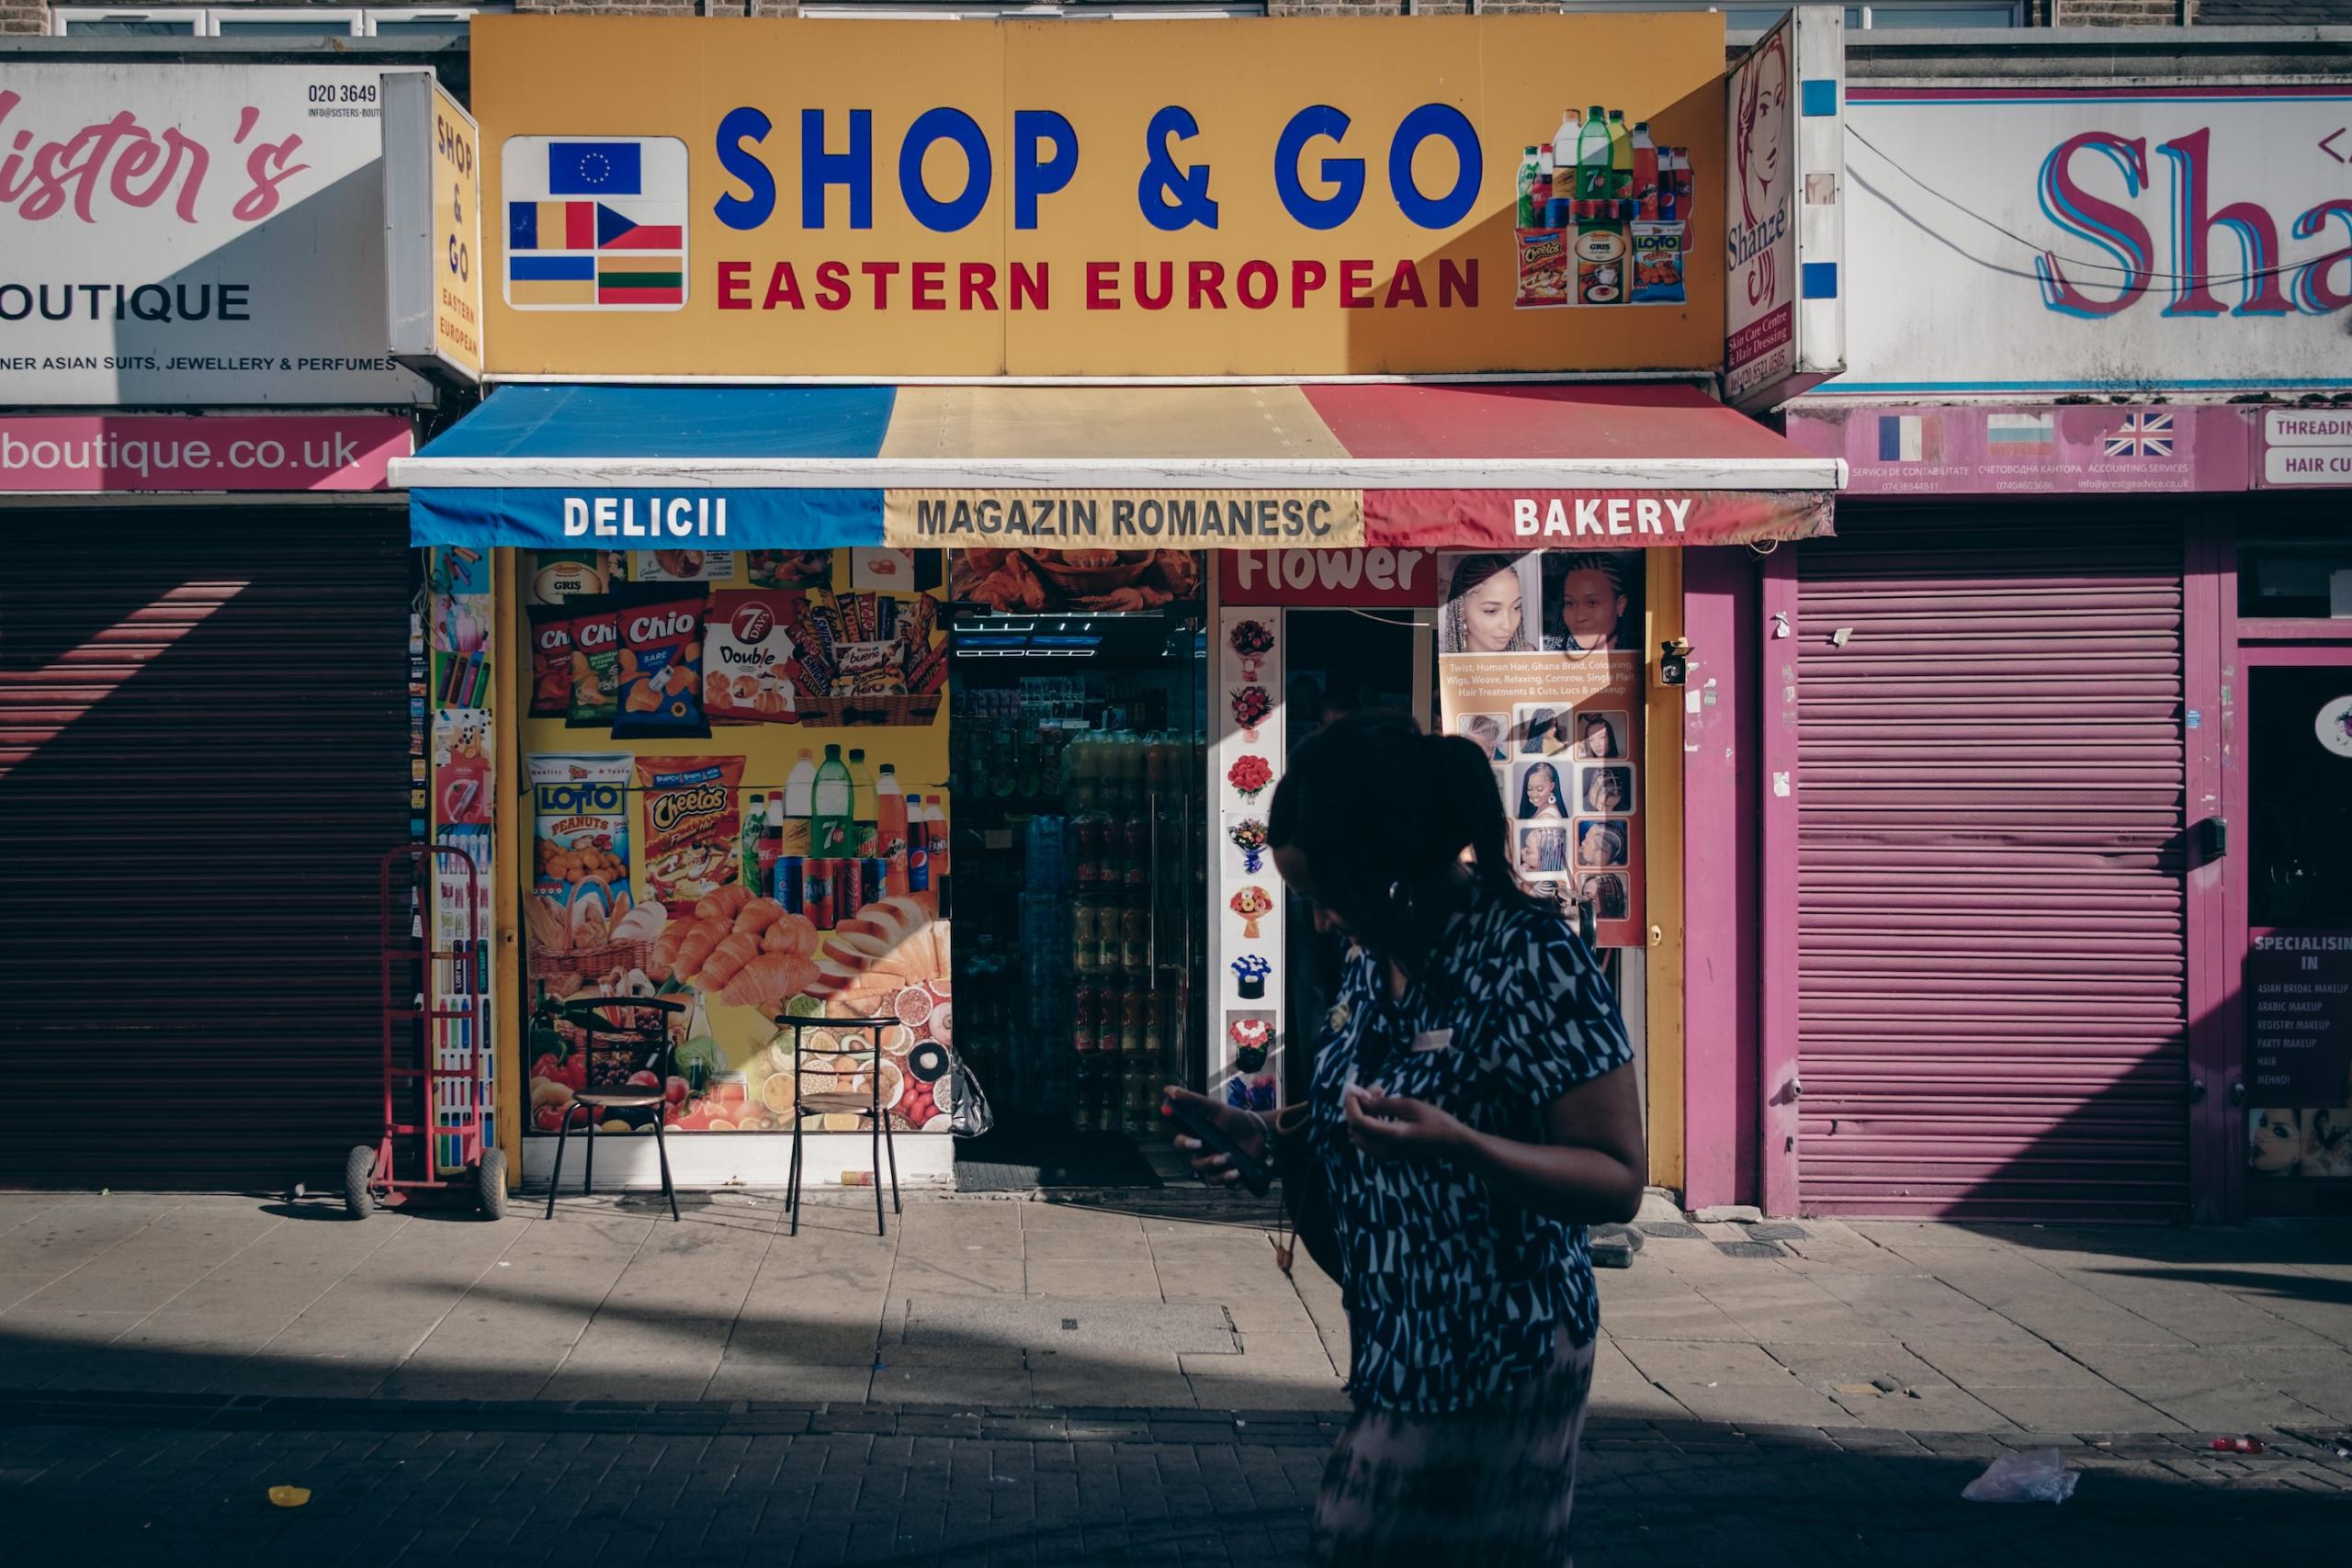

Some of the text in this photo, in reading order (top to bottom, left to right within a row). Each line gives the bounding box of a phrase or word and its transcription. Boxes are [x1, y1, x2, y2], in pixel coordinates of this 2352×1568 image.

[309, 85, 376, 102] 020 3649
[437, 114, 472, 180] SHOP
[0, 90, 311, 223] ister's
[714, 103, 1483, 232] SHOP & GO
[454, 183, 462, 222] &
[449, 234, 469, 283] GO
[717, 258, 1480, 311] EASTERN EUROPEAN
[443, 288, 475, 326] EASTERN
[440, 317, 478, 357] EUROPEAN
[1728, 310, 1787, 352] Skin Care Centre
[1736, 345, 1753, 364] Hair
[1753, 326, 1787, 354] Dressing
[42, 357, 97, 370] ASIAN
[104, 357, 160, 373] SUITS,
[165, 357, 275, 371] JEWELLERY
[279, 357, 292, 371] &
[297, 357, 396, 372] PERFUMES
[1889, 467, 1900, 477] DE
[1903, 466, 1970, 476] CONTABILITATE
[2041, 464, 2082, 474] КАНТОРА
[2087, 463, 2188, 473] ACCOUNTING SERVICES
[2286, 457, 2324, 472] HAIR
[563, 497, 727, 536] DELICII
[917, 499, 1331, 536] MAGAZIN ROMANESC
[1513, 497, 1692, 536] BAKERY
[554, 581, 581, 590] GRIS
[628, 611, 695, 644] Chio
[739, 608, 771, 640] 7 DAYS
[643, 650, 668, 662] SARE
[850, 651, 879, 664] bueno
[1476, 663, 1509, 672] Human
[1532, 662, 1559, 671] Ghana
[1472, 676, 1501, 685] Weave,
[1504, 675, 1544, 685] Relaxing,
[1545, 674, 1585, 683] Cornrow,
[1459, 686, 1625, 697] Hair Treatments & Cuts, Locs & makeup
[542, 784, 617, 814] LOTTO
[654, 785, 728, 832] Cheetos
[551, 817, 608, 836] PEANUTS
[2301, 956, 2319, 970] IN
[455, 970, 463, 988] LOST
[2257, 984, 2349, 993] ASIAN BRIDAL MAKEUP
[2257, 1002, 2323, 1011] ARABIC MAKEUP
[2257, 1020, 2330, 1030] REGISTRY MAKEUP
[2257, 1038, 2317, 1048] PARTY MAKEUP
[2257, 1056, 2278, 1066] HAIR
